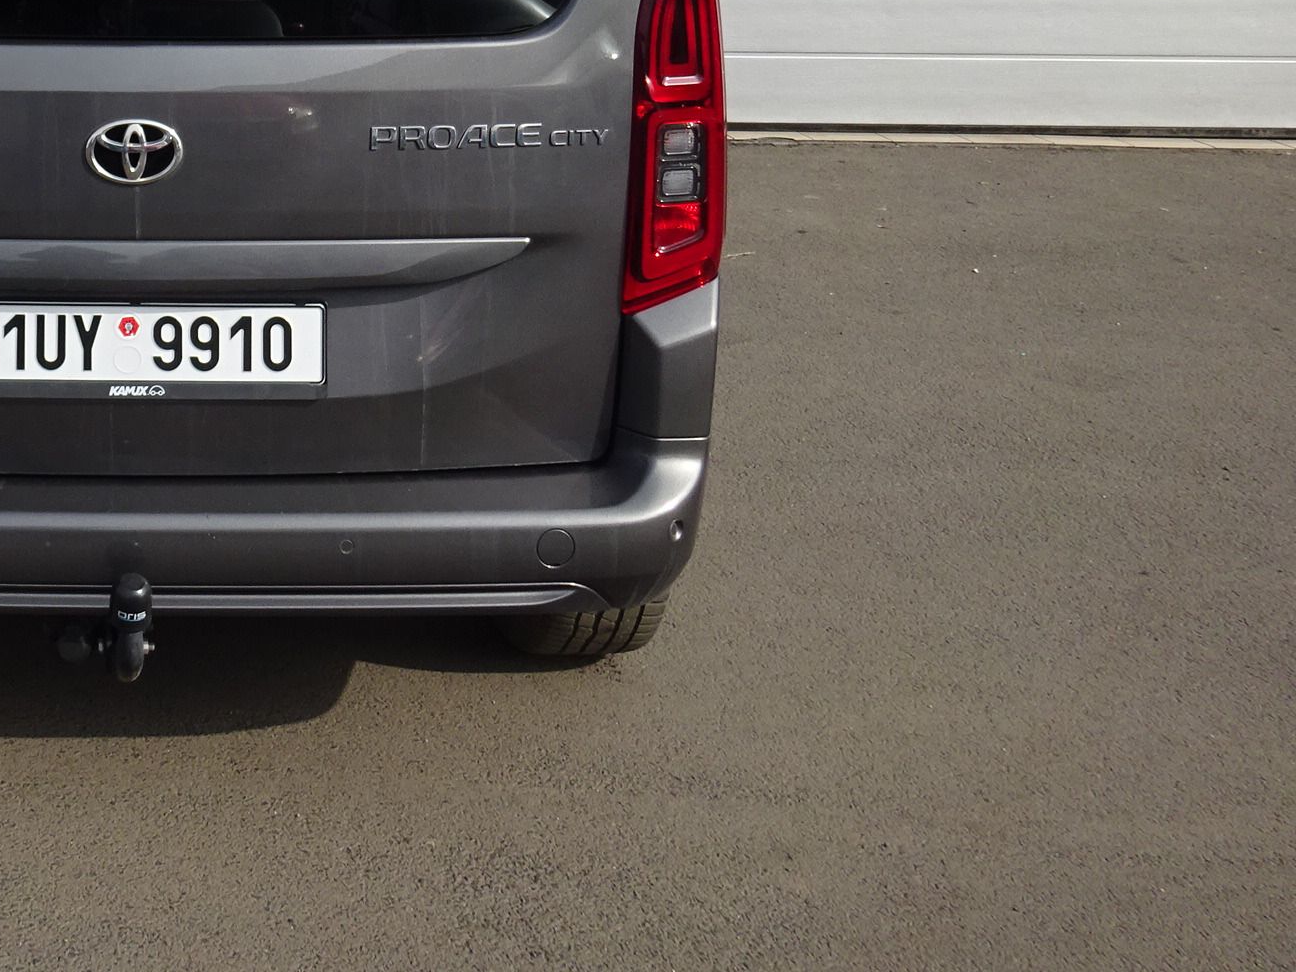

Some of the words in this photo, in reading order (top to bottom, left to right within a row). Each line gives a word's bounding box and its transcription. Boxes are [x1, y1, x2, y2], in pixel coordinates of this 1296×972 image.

[370, 123, 543, 151] PROACE
[549, 128, 609, 146] CITY
[3, 314, 102, 371] 1UY
[152, 315, 292, 372] 9910
[109, 385, 149, 396] KAMUX
